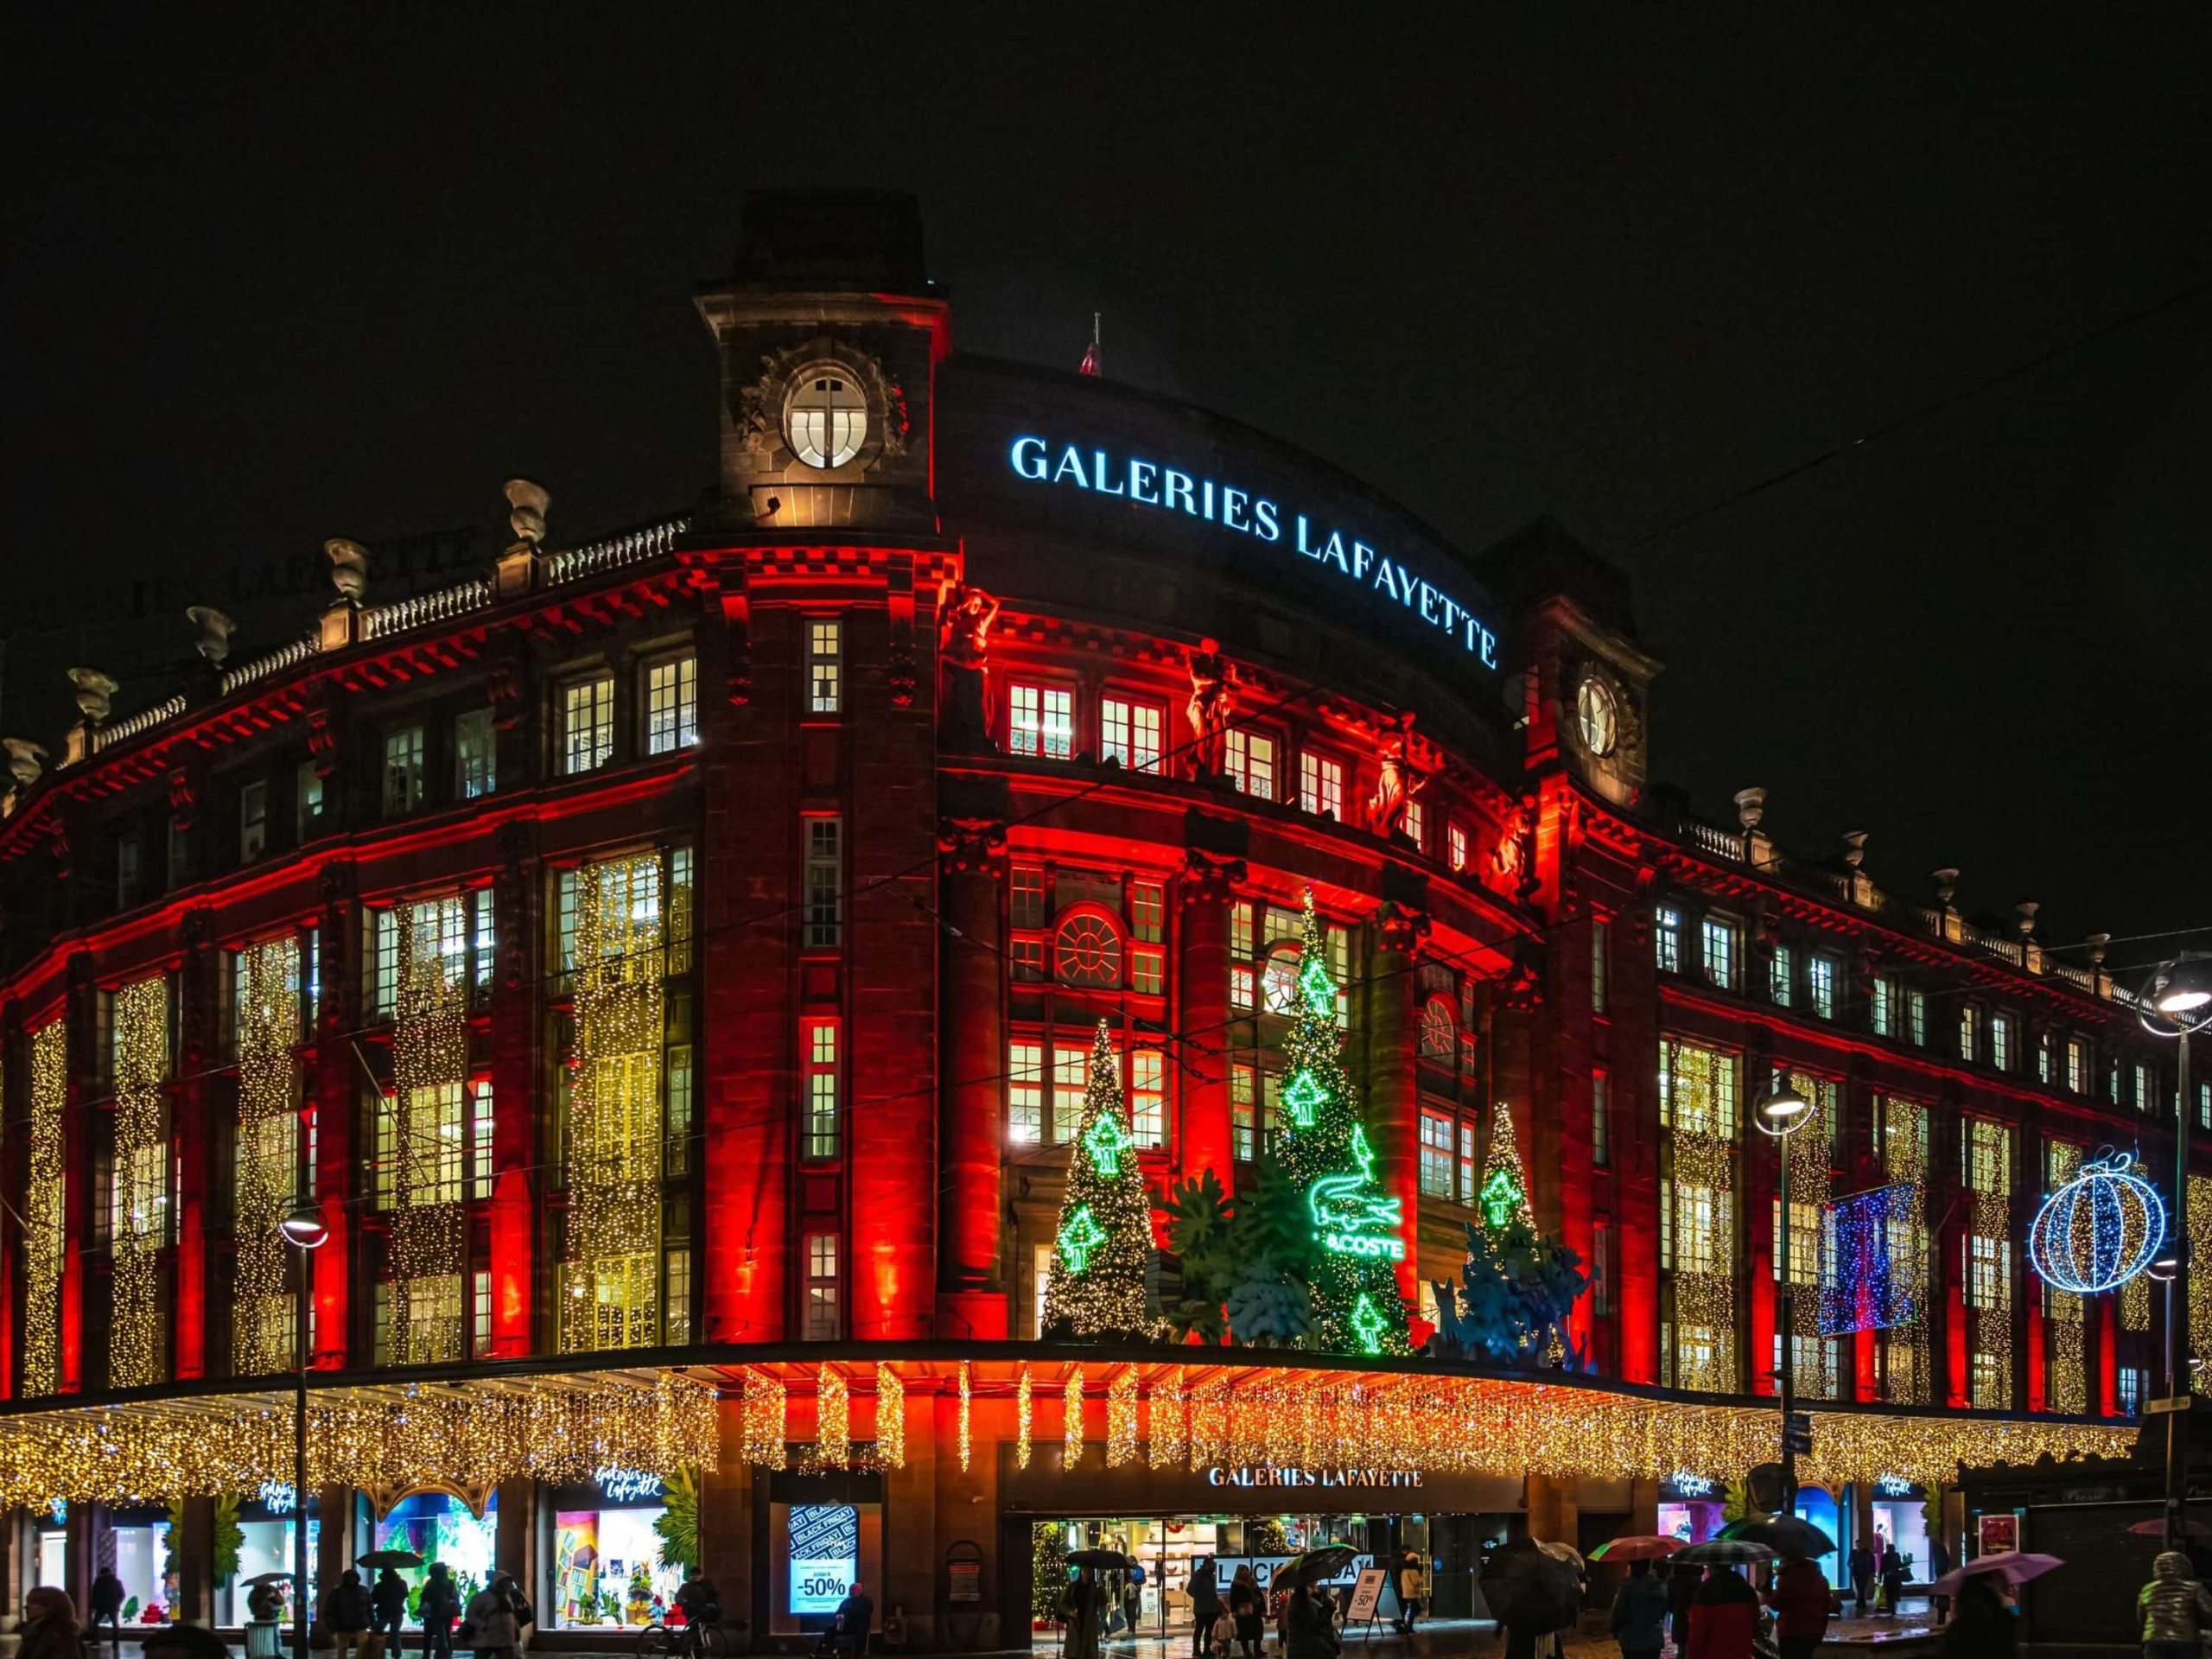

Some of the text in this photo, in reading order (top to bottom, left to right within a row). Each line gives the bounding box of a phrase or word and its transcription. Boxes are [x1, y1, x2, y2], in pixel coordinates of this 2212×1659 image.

[1010, 437, 1497, 671] GALERIES LAFAYETTE
[1312, 1232, 1405, 1259] ACOSTE
[1209, 1467, 1423, 1488] GALERIES LAFAYETTE
[797, 1509, 850, 1541] BLACK FRIDAY
[811, 1532, 838, 1551] FRIDAY
[797, 1578, 846, 1597] -50%
